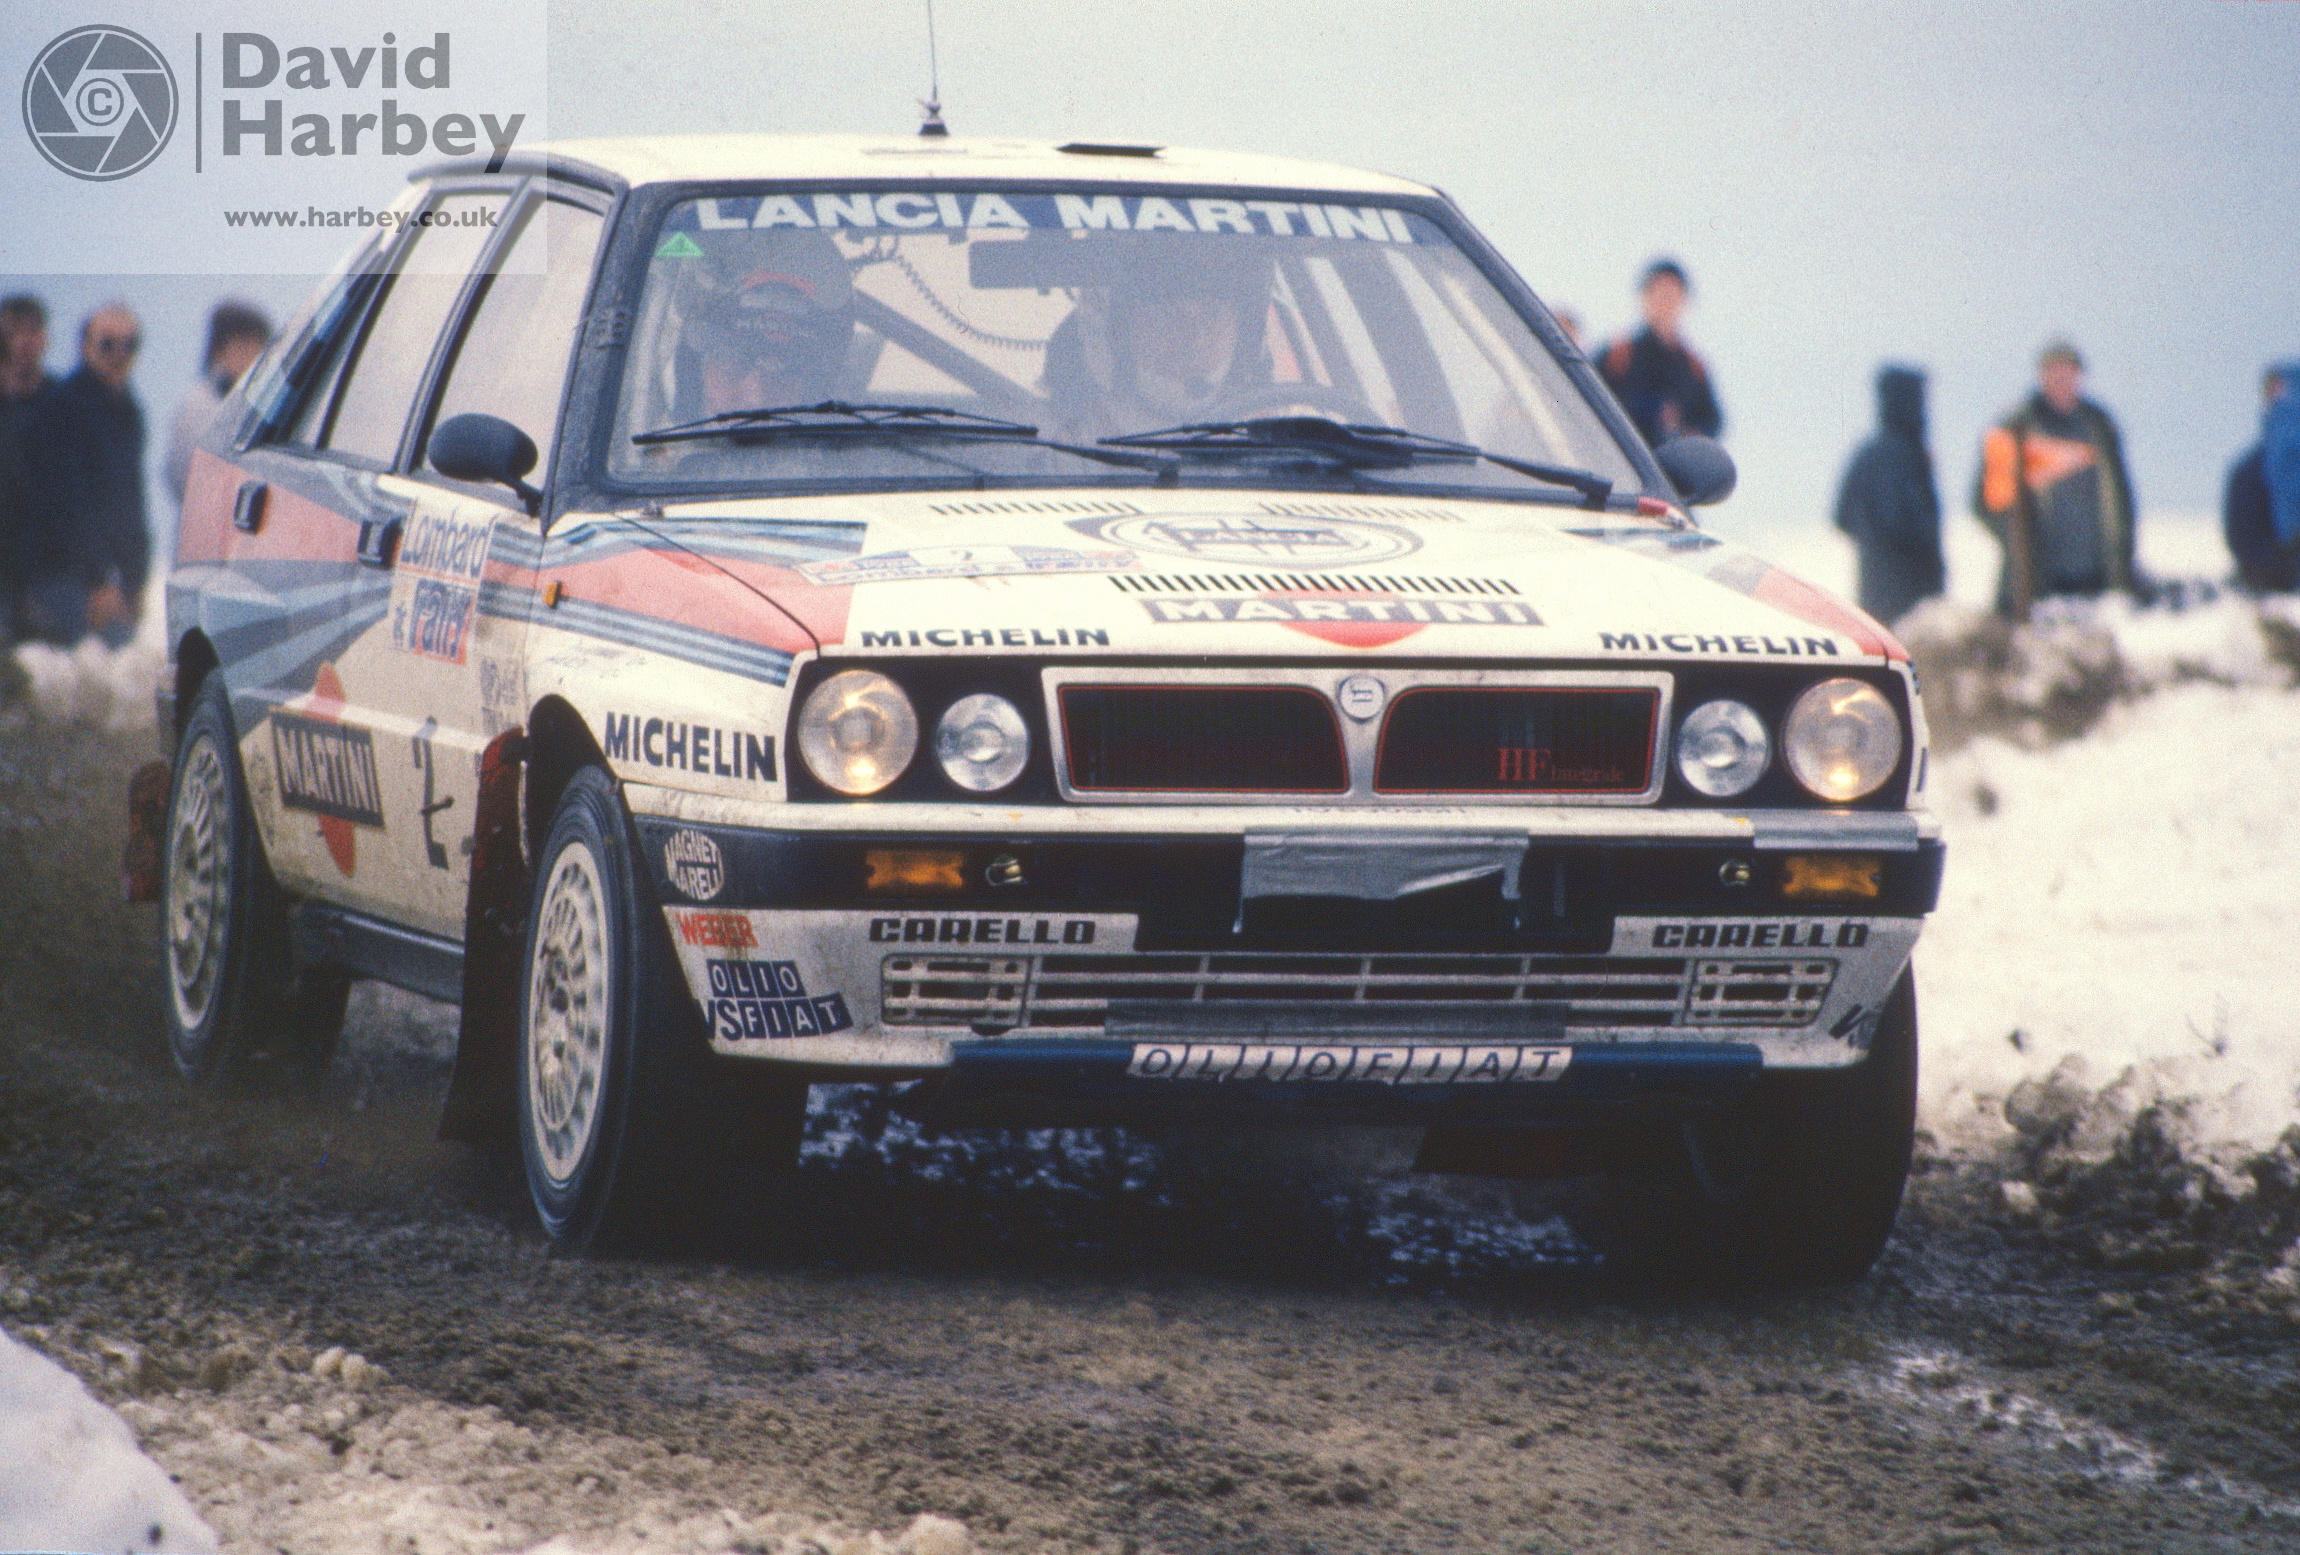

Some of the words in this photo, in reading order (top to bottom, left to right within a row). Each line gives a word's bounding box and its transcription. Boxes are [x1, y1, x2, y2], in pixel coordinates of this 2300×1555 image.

[700, 192, 1029, 231] LANCIA
[1054, 197, 1412, 243] MARTINI
[1153, 599, 1532, 624] MARTINI
[861, 628, 1110, 647] MICHELIN
[1600, 632, 1838, 656] MICHELIN
[605, 712, 778, 782] MICHELIN
[275, 725, 380, 814] MARTINI
[676, 911, 760, 947] WEBER
[869, 918, 1096, 944] CARELLO
[1652, 924, 1869, 949] CARELLO
[710, 962, 801, 995] OLIO
[742, 998, 844, 1036] FIAT
